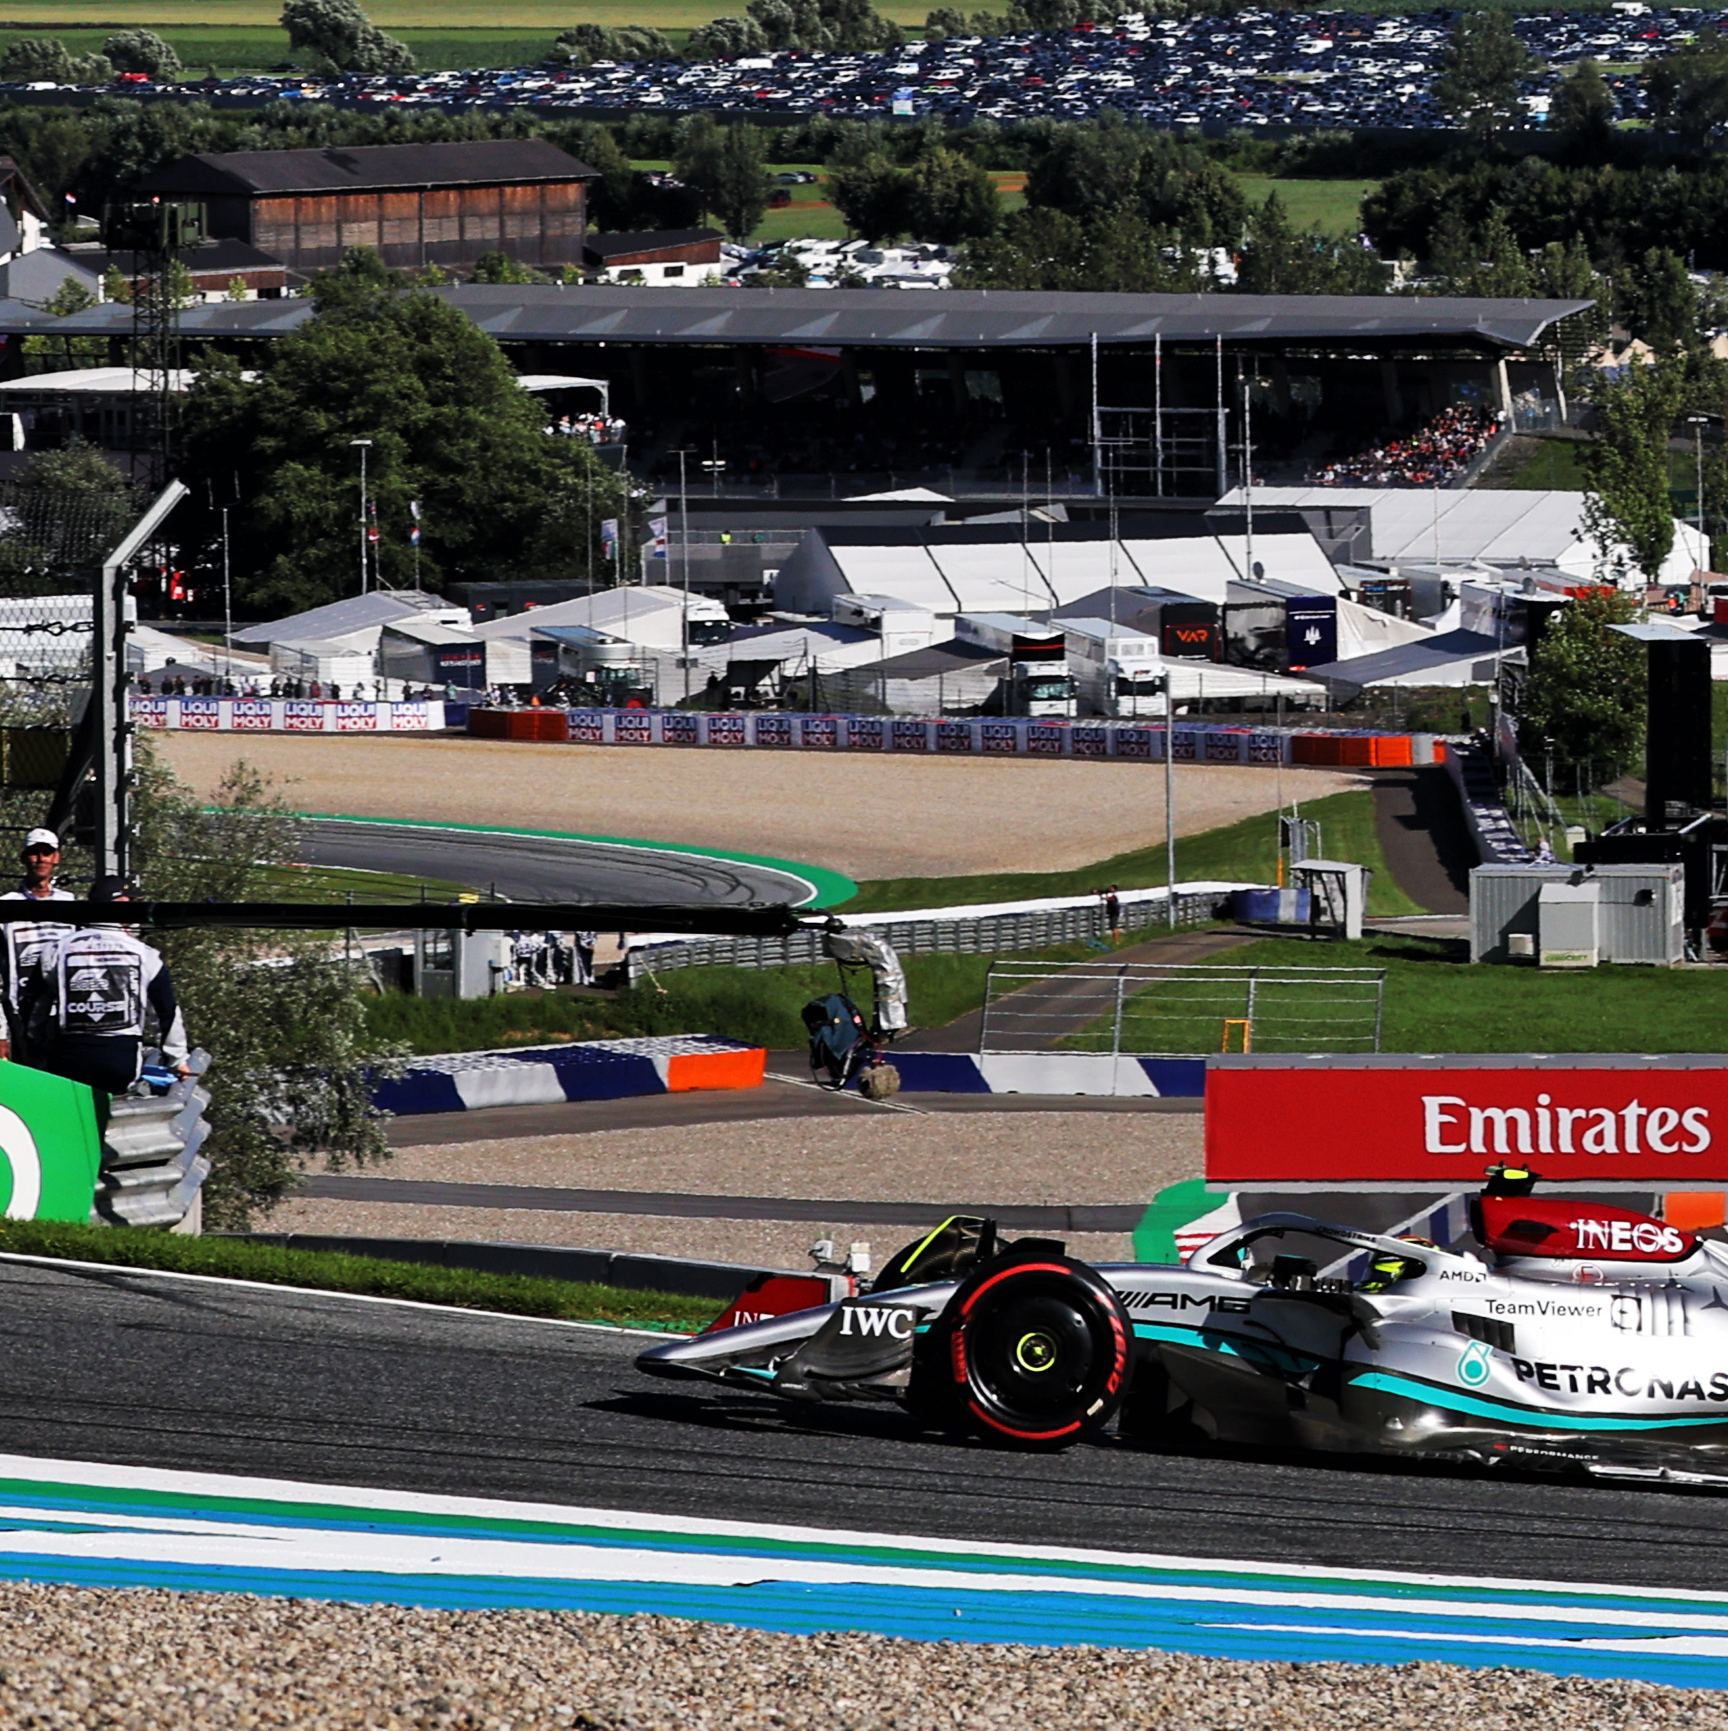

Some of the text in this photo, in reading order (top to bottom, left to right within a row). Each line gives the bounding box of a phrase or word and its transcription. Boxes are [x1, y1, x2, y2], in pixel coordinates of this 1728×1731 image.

[182, 702, 218, 714] LIQUI
[233, 703, 270, 715] LIQUI
[285, 703, 322, 716] LIQUI
[337, 703, 375, 716] LIQUI
[392, 702, 427, 715] LIQUI
[182, 716, 219, 727] MOLY
[234, 716, 271, 727] MOLY
[285, 717, 323, 729] MOLY
[337, 717, 376, 729] MOLY
[393, 717, 428, 728] MOLY
[568, 715, 601, 727] LIQUI
[616, 716, 648, 728] LIQUI
[663, 718, 696, 729] LIQUI
[710, 719, 743, 730] LIQUI
[568, 728, 601, 740] MOLY
[616, 730, 649, 741] MOLY
[664, 731, 697, 743] MOLY
[710, 732, 744, 744] MOLY
[1421, 1093, 1712, 1154] Emirates
[1577, 1219, 1685, 1253] INEOS
[1440, 1270, 1473, 1282] AMD
[1485, 1298, 1603, 1319] TeamViewer
[840, 1305, 914, 1339] IWC
